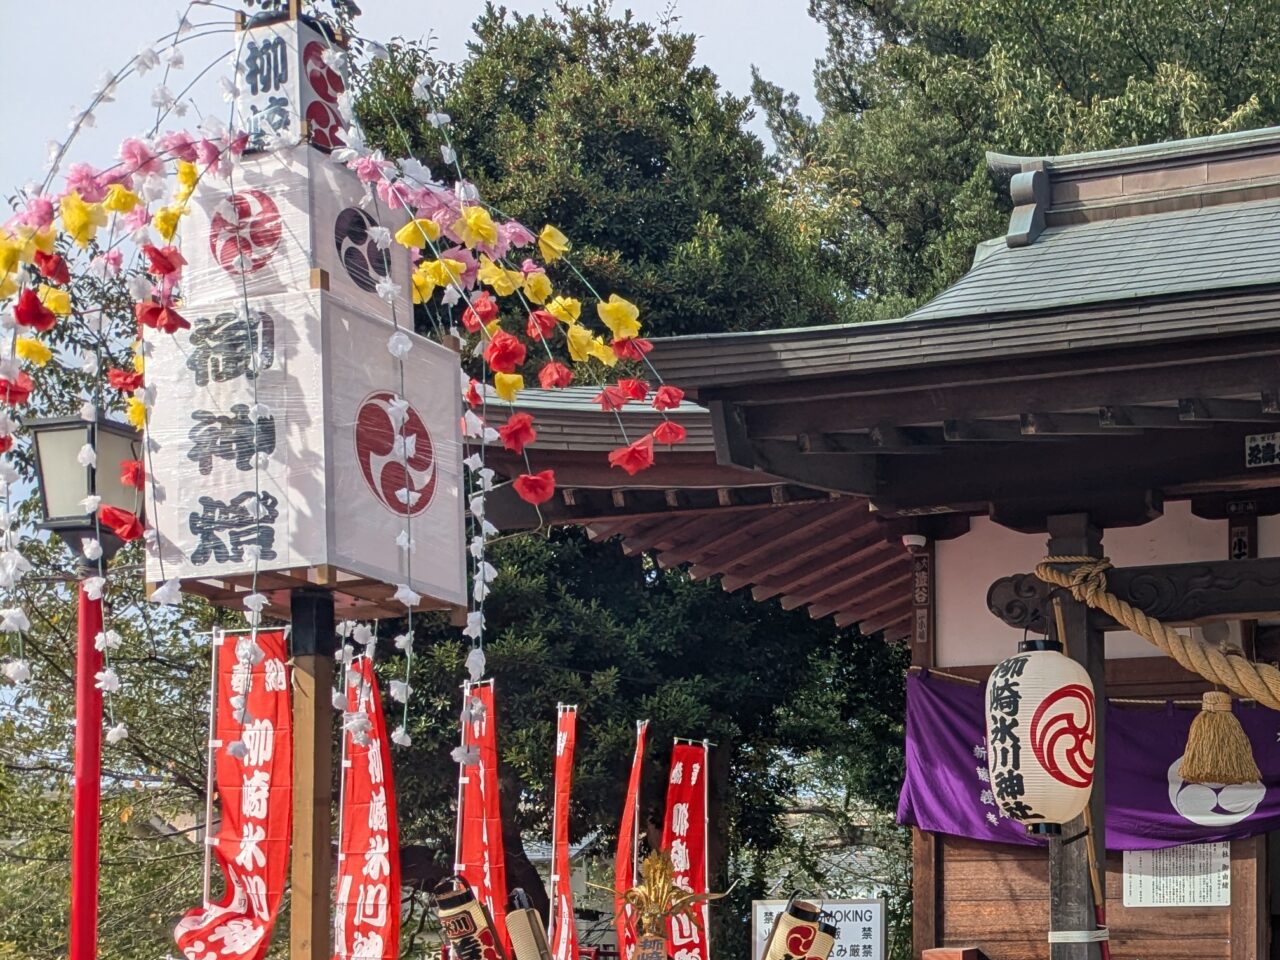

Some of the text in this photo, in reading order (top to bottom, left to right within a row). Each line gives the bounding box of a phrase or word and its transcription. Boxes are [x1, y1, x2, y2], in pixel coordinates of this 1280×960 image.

[187, 311, 278, 564] 御神燈
[990, 655, 1046, 821] 柳崎氷川神社
